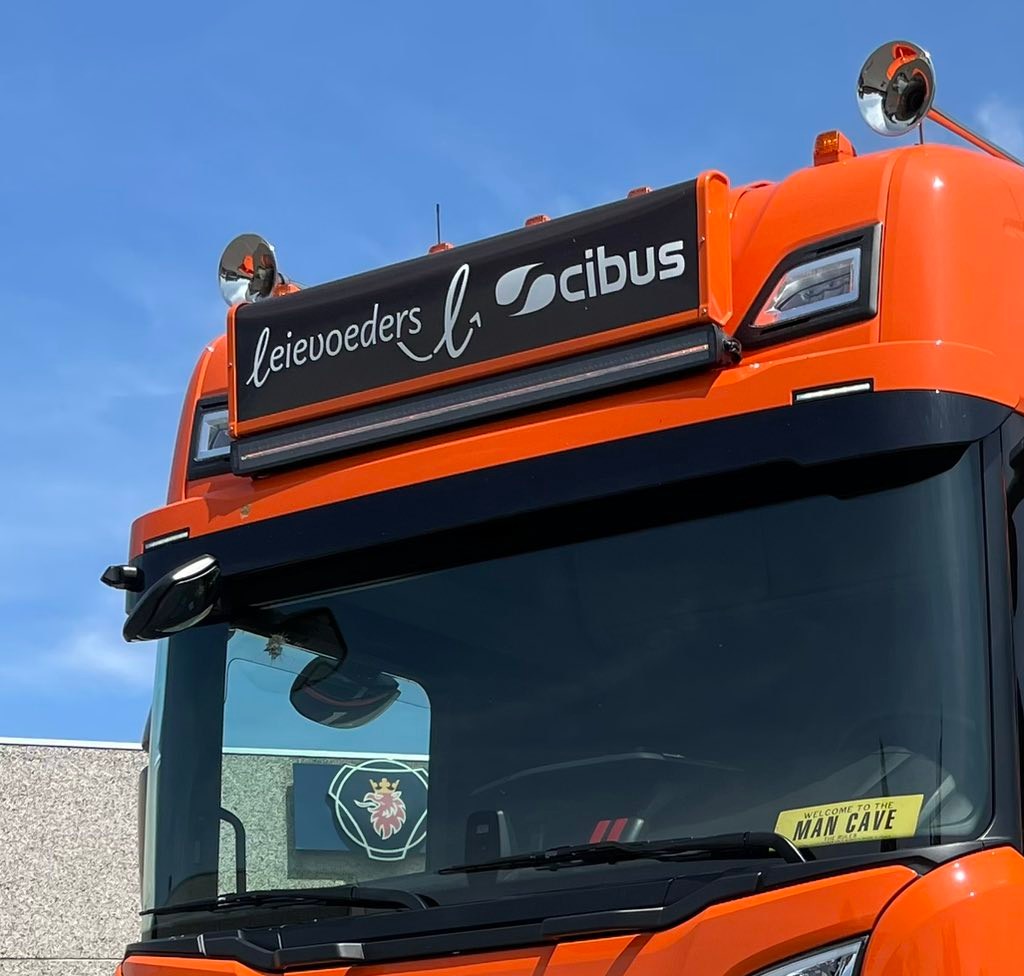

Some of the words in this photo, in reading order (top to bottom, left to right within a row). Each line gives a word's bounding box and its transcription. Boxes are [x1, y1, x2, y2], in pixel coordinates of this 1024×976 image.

[246, 303, 422, 388] leievoeders
[558, 240, 686, 303] cibus
[792, 815, 839, 841] MAN
[845, 809, 897, 834] CAVE
[803, 806, 852, 820] WELCOME
[857, 803, 871, 813] TO
[875, 801, 894, 811] THE
